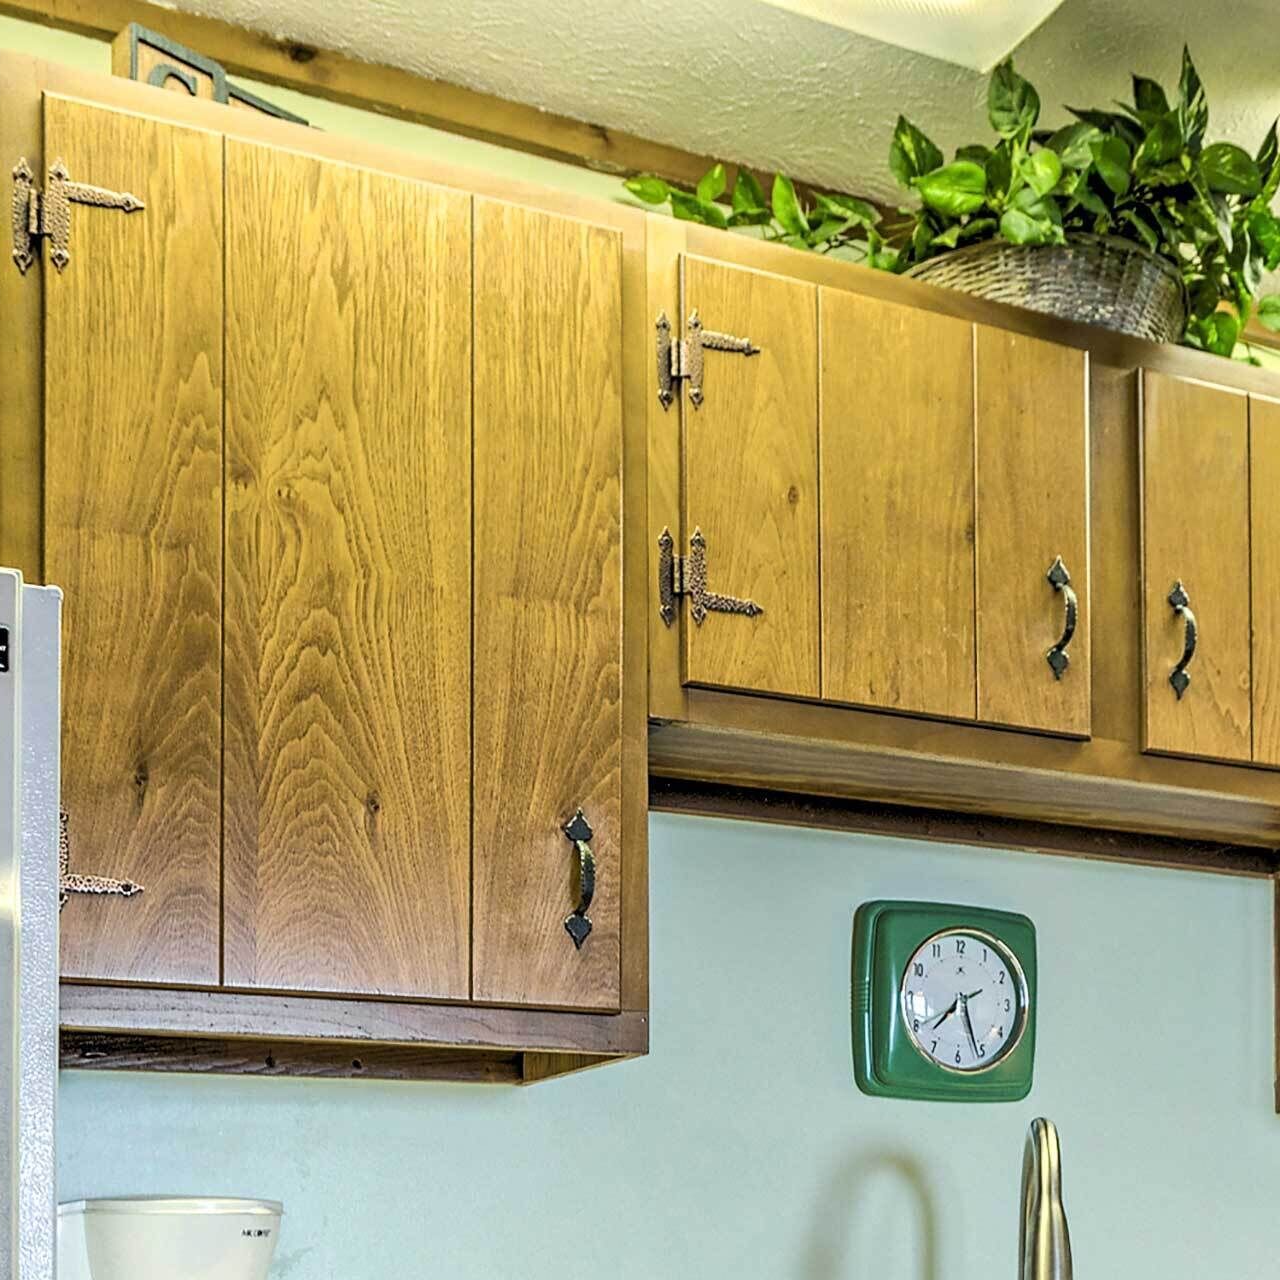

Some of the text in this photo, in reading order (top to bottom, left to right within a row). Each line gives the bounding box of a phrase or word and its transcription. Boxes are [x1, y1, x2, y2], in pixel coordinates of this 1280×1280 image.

[932, 944, 941, 958] 11
[956, 940, 966, 954] 12
[982, 949, 988, 962] 1
[913, 962, 924, 977] 10
[998, 971, 1005, 985] 2
[1003, 999, 1010, 1013] 3
[931, 1040, 938, 1054] 7
[979, 1044, 986, 1059] 5
[954, 1050, 962, 1064] 6
